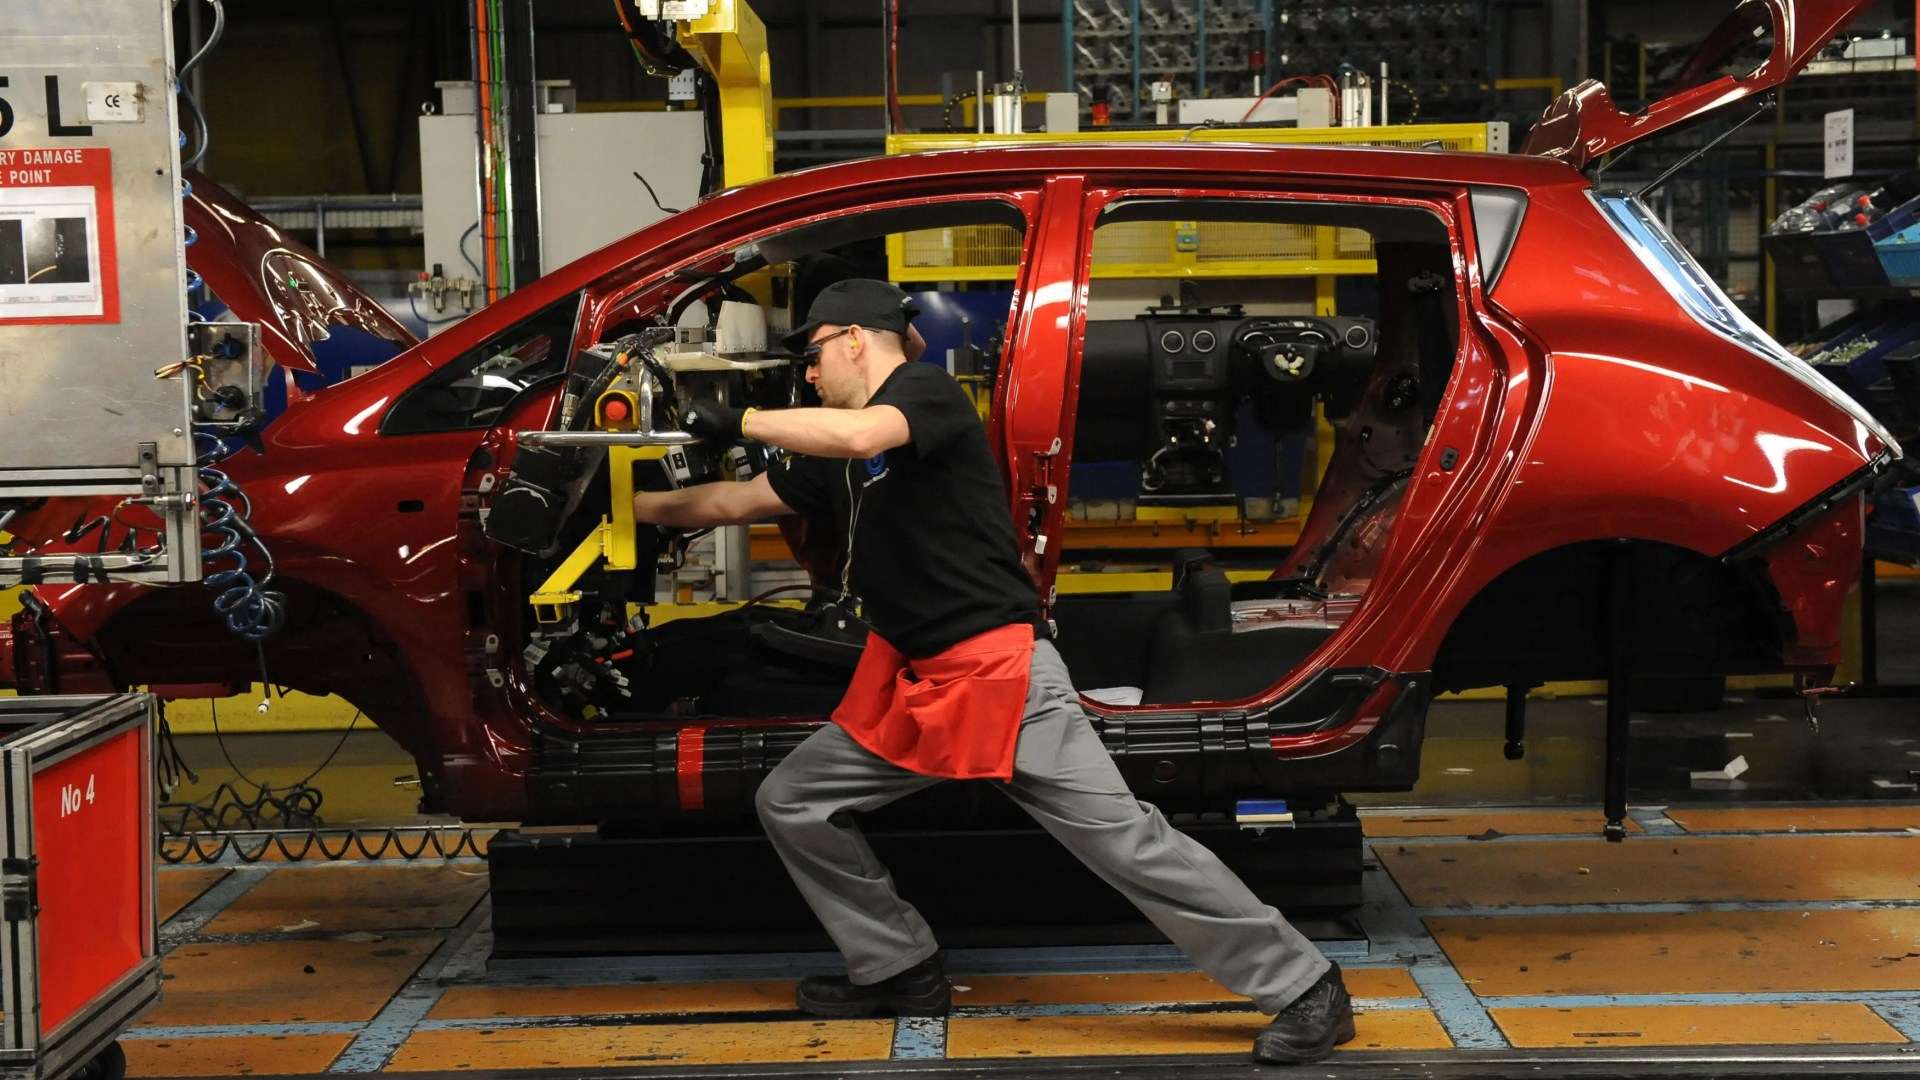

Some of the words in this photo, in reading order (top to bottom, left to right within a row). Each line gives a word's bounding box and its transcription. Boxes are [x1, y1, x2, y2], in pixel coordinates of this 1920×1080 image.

[45, 75, 93, 137] L
[105, 95, 120, 108] CE
[23, 150, 83, 164] DAMAGE
[10, 169, 52, 184] POINT
[61, 784, 81, 817] No
[86, 774, 95, 805] 4
